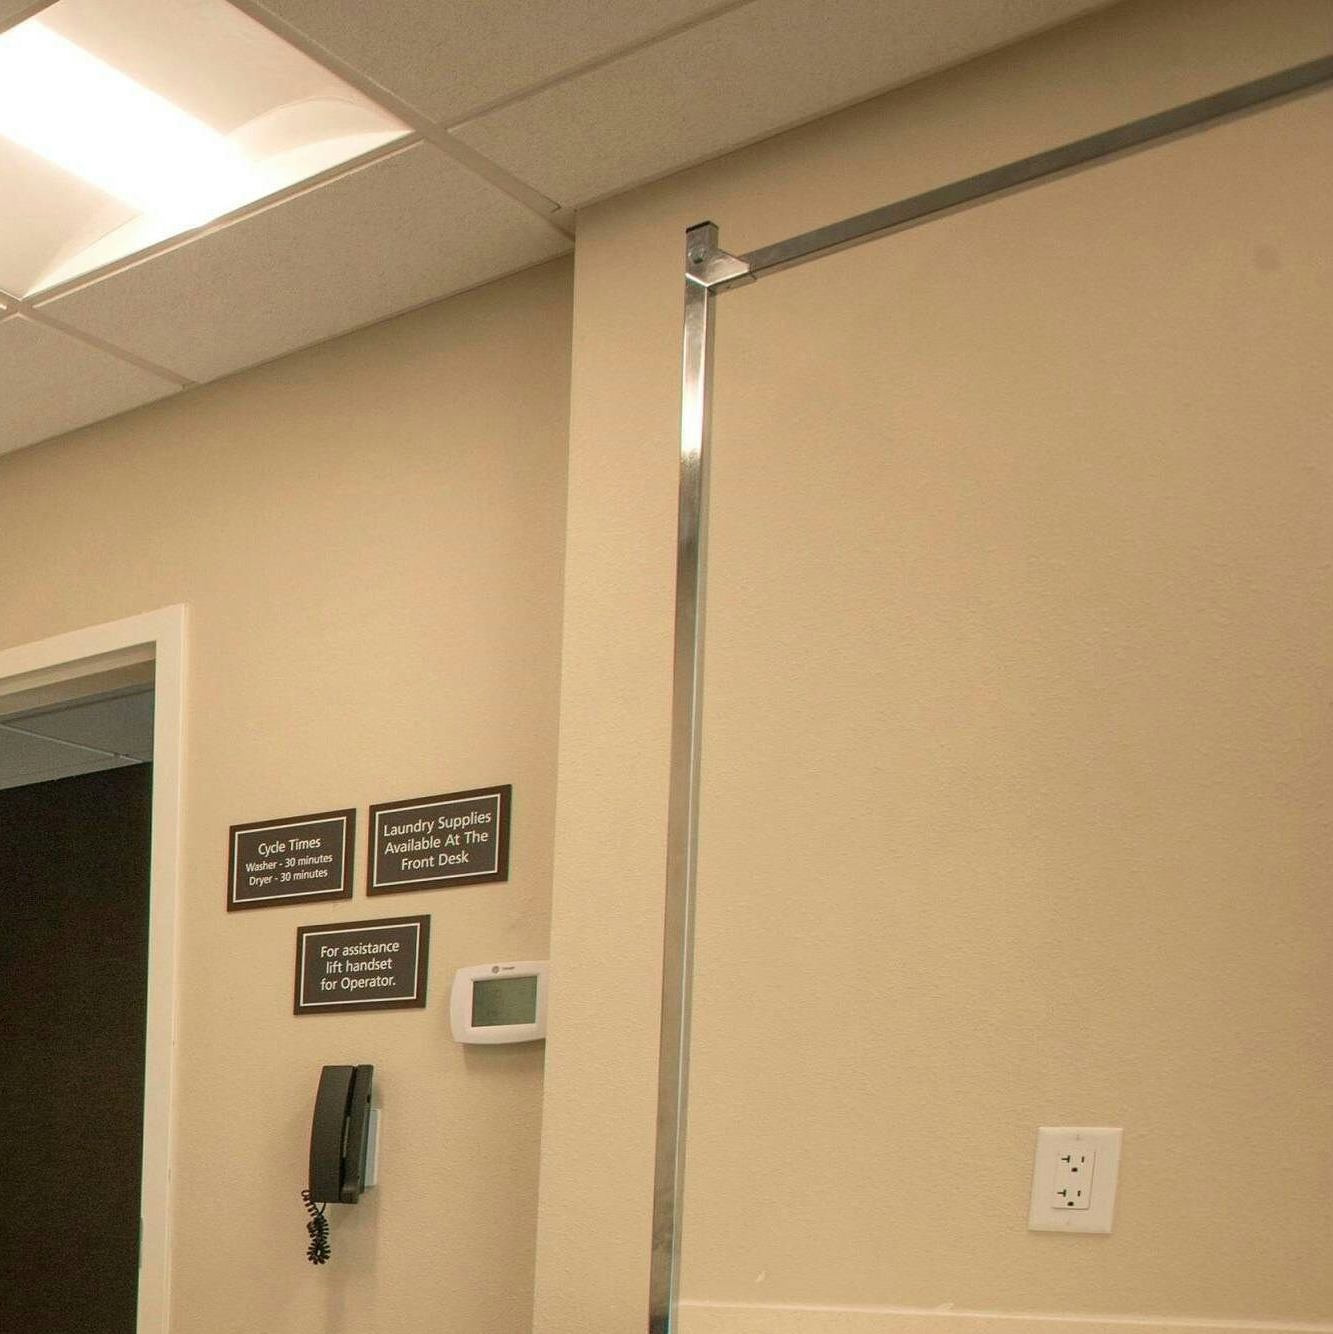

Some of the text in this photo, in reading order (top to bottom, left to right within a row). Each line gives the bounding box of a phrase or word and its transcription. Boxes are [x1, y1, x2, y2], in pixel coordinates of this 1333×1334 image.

[383, 812, 492, 837] Laundry Supplies
[258, 838, 321, 857] Cycle Times
[384, 830, 489, 855] Available At The
[245, 860, 278, 872] Washer
[284, 857, 296, 868] 30
[297, 853, 333, 866] minutes
[401, 850, 470, 871] Front Desk
[249, 874, 273, 887] Dryer
[280, 872, 292, 882] 30
[293, 868, 329, 880] minutes
[320, 942, 400, 958] For assistance
[326, 957, 393, 974] lift handset
[320, 975, 396, 992] for Operator.
